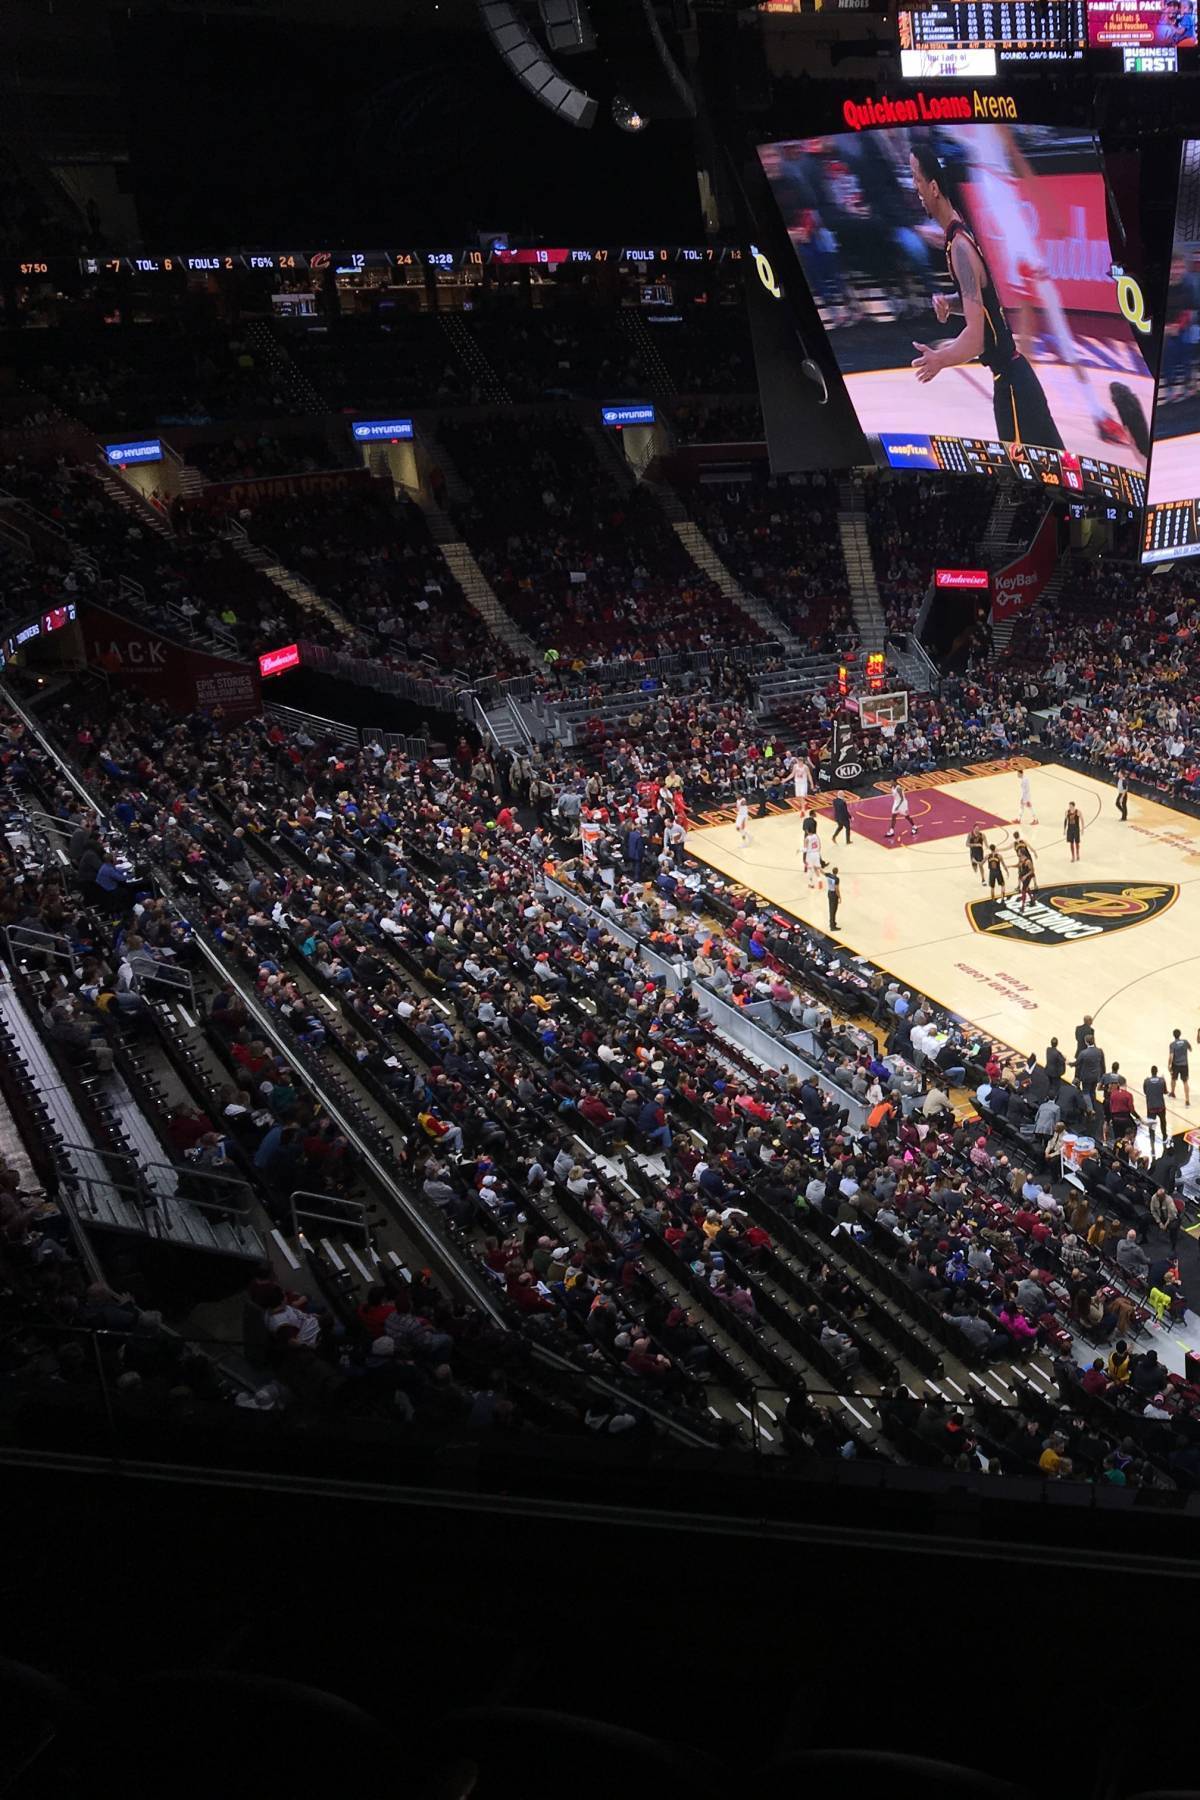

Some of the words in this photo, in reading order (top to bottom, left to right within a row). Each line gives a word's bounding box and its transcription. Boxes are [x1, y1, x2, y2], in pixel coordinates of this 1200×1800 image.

[1088, 1, 1118, 11] FAMILY
[1120, 1, 1137, 11] FUN
[1140, 1, 1162, 10] PACK
[1125, 47, 1175, 57] BUSINESS
[843, 98, 919, 129] Quicken
[917, 93, 972, 121] Loans
[973, 90, 1018, 119] Arena
[250, 256, 274, 269] FG%
[279, 256, 295, 268] 24
[351, 254, 365, 268] 12
[396, 254, 413, 266] 24
[427, 253, 454, 265] 3:28
[536, 251, 549, 264] 19
[572, 251, 592, 263] FG%
[595, 250, 609, 262] 47
[626, 250, 655, 262] FOULS
[659, 250, 668, 261] 0
[683, 250, 704, 262] TOL:
[707, 250, 714, 261] 7
[136, 259, 159, 272] TOL:
[164, 259, 173, 271] 6
[188, 257, 220, 270] FOULS
[225, 257, 233, 269] 2
[756, 253, 781, 298] Q
[1117, 275, 1151, 333] Q
[619, 410, 653, 420] HYUNDAI
[371, 424, 411, 435] HYUNDAI
[124, 446, 160, 459] HYUNDAI
[1019, 463, 1033, 480] 12
[1066, 471, 1079, 489] 19
[1106, 508, 1117, 519] 12
[937, 572, 986, 585] Budweiser
[867, 662, 883, 676] 24
[837, 765, 860, 777] KIA
[954, 962, 989, 984] Loans
[994, 972, 1034, 993] Arena
[988, 981, 1039, 1010] Quicken
